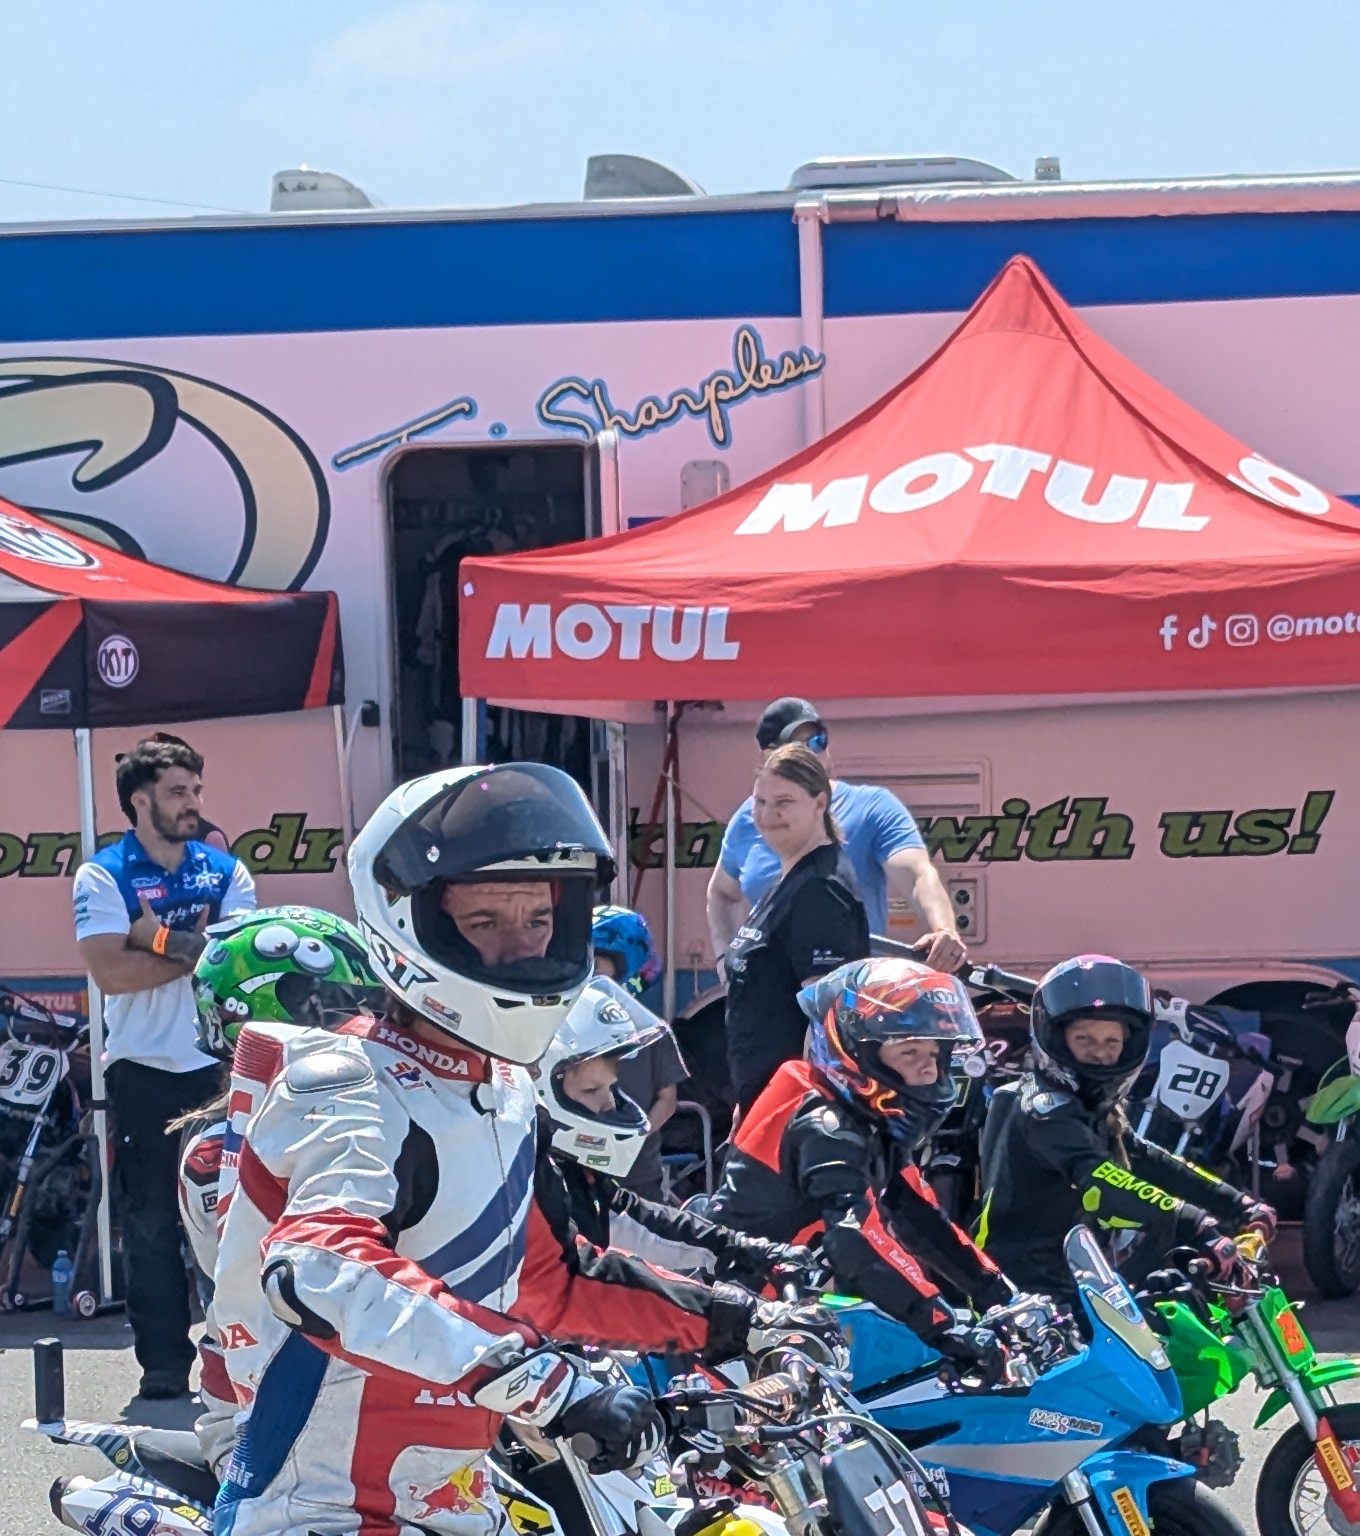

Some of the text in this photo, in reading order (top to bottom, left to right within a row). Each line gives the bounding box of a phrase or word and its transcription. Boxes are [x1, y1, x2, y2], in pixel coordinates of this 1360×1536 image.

[538, 325, 827, 448] Sharpless
[734, 443, 1212, 536] MOTUL
[485, 603, 740, 661] MOTUL
[917, 796, 1136, 863] with
[1158, 788, 1337, 859] us!
[377, 1026, 470, 1076] HONDA
[1167, 1063, 1221, 1101] 28
